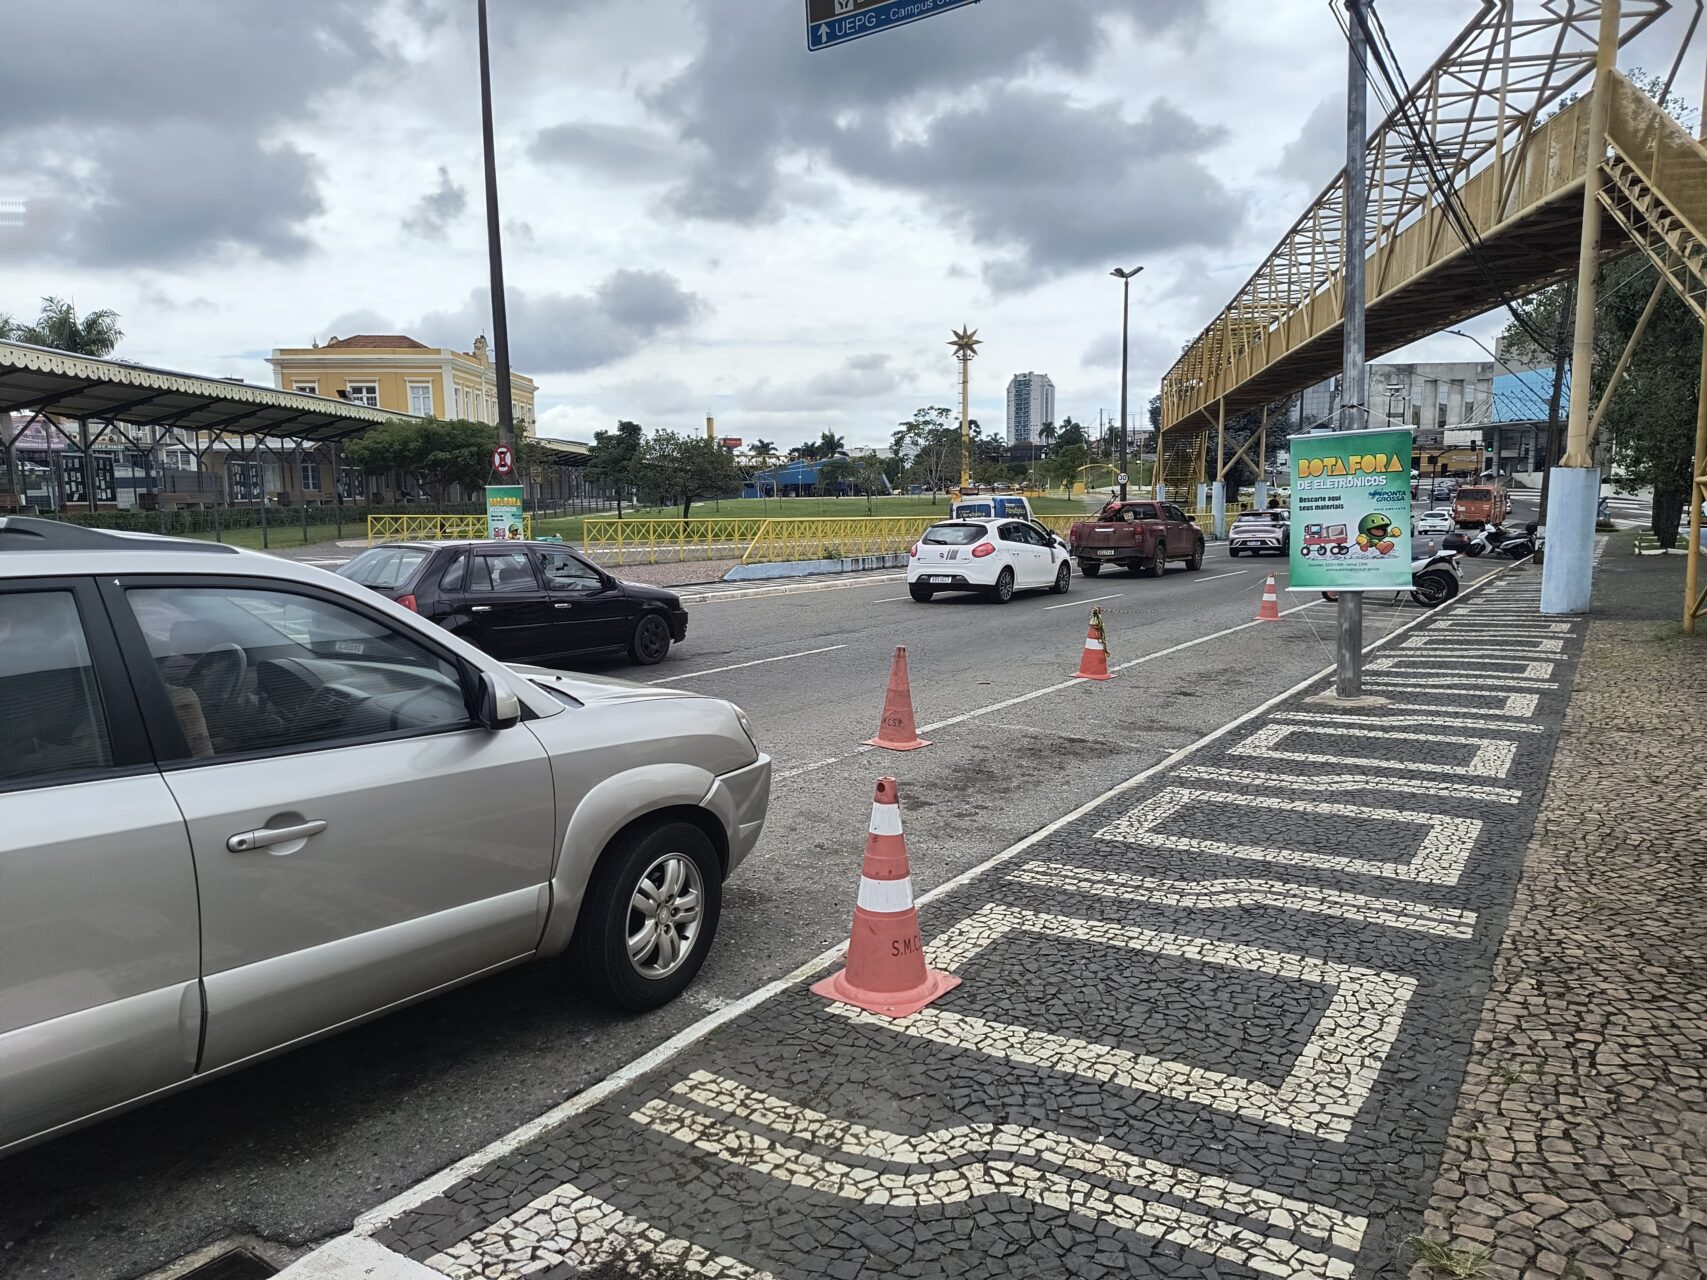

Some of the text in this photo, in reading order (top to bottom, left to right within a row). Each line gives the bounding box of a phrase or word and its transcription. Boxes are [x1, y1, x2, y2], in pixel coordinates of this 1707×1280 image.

[835, 12, 876, 36] UEPG
[890, 1, 933, 20] Campus
[1297, 475, 1387, 491] DE ELETRÔNICOS
[1327, 495, 1341, 503] aqui
[1376, 495, 1405, 503] GROSSA
[1299, 503, 1344, 512] seus materiais
